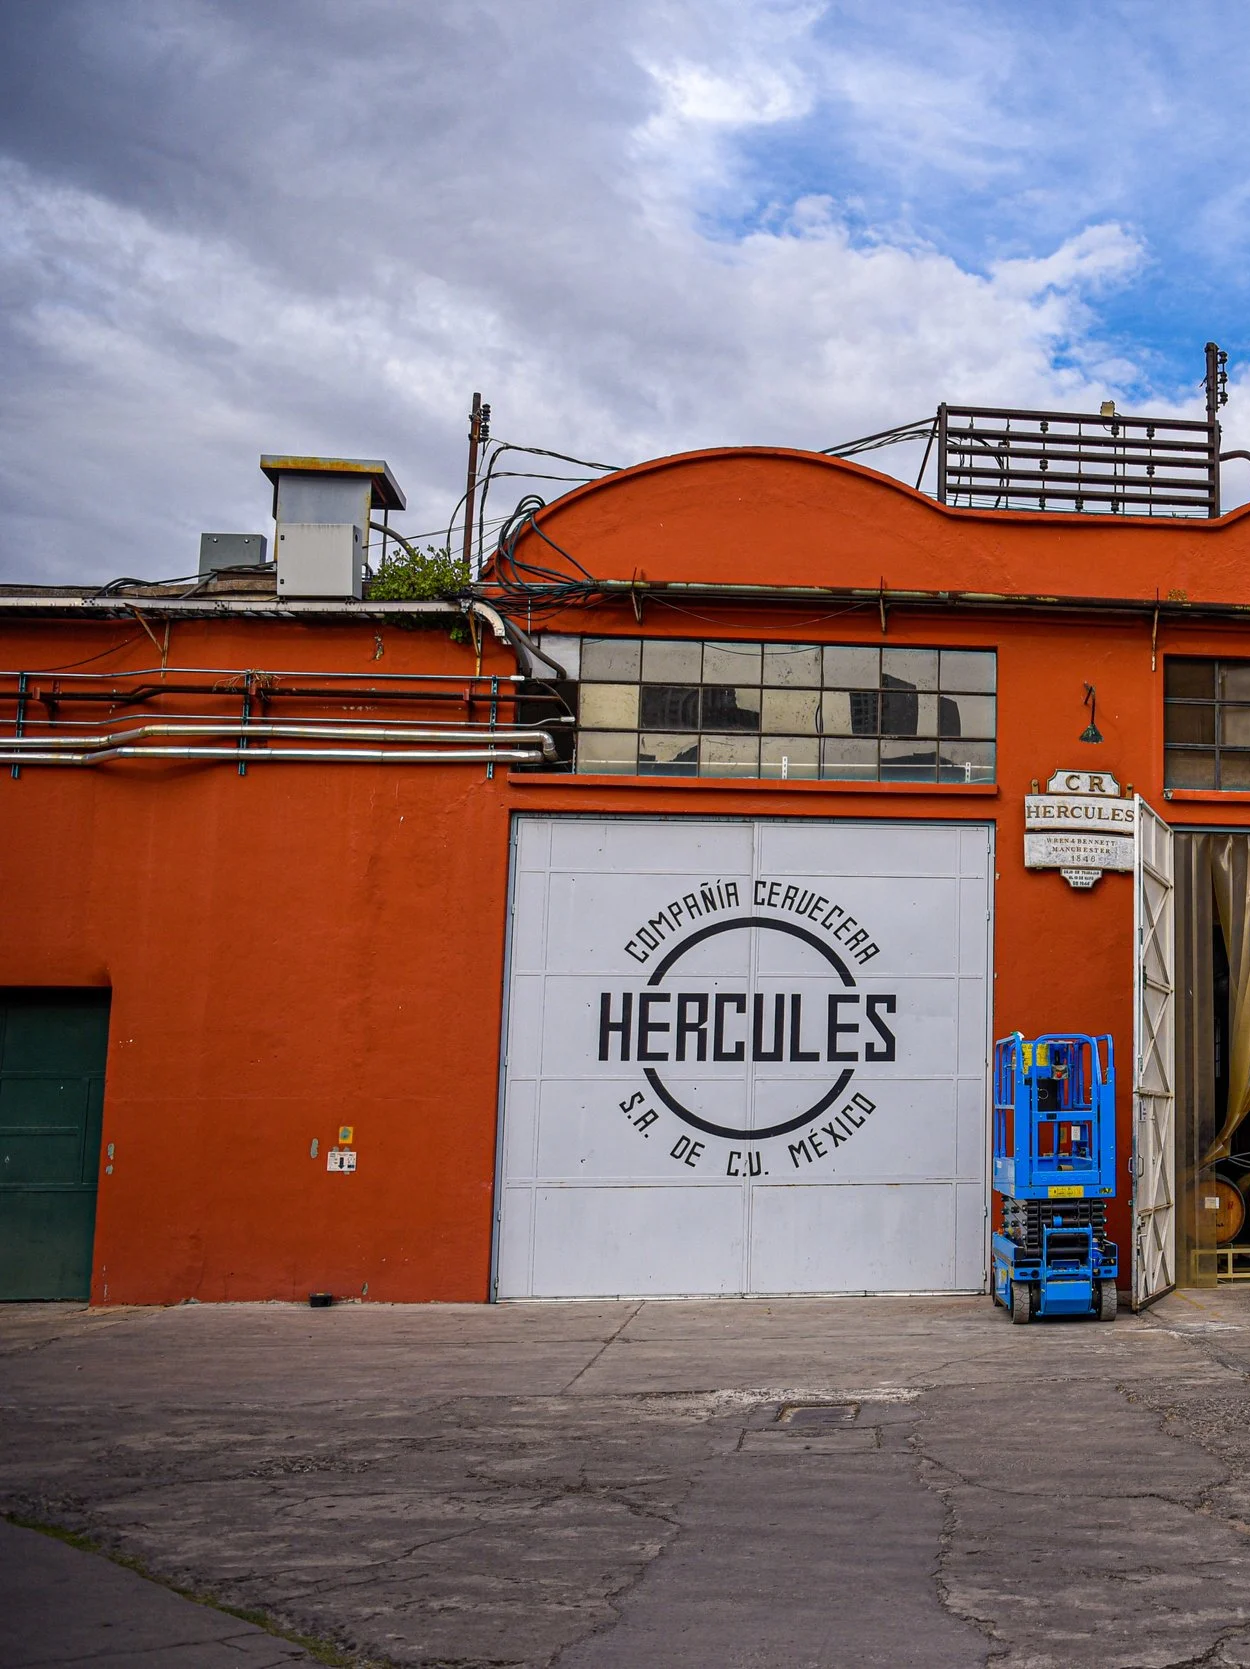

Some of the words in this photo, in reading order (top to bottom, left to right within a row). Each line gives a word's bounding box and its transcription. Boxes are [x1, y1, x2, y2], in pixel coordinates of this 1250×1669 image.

[1027, 805, 1134, 822] HERCULES
[624, 879, 740, 964] COMPAÑÍA
[754, 880, 880, 966] CERVECERA
[598, 992, 897, 1062] HERCULES
[619, 1091, 660, 1139] S.A.
[669, 1134, 705, 1168] DE
[787, 1091, 877, 1169] MÉXICO
